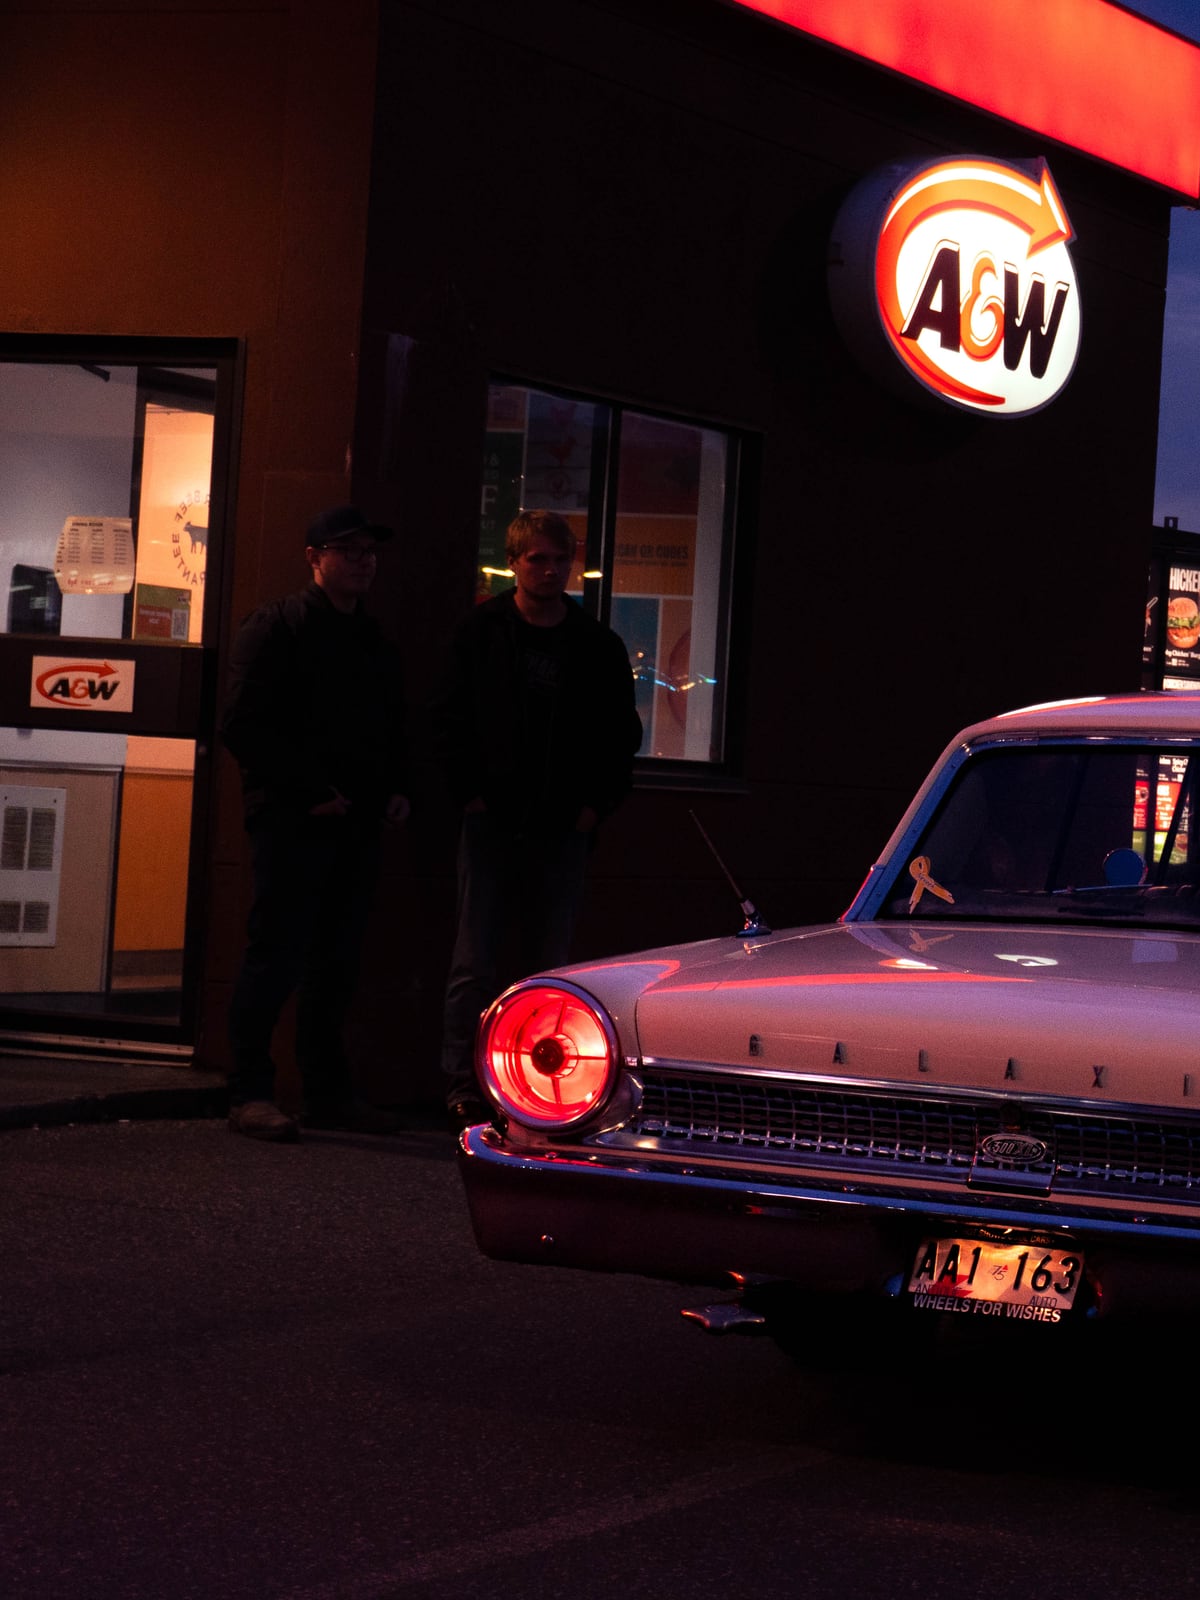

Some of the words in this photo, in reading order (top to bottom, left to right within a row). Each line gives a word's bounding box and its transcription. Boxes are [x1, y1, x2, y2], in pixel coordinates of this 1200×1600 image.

[900, 238, 1070, 379] A&W
[47, 677, 120, 701] A&W
[1013, 1252, 1081, 1294] 163
[913, 1294, 971, 1313] WHEELS
[973, 1300, 1003, 1317] FOR
[1005, 1303, 1062, 1323] WISHES
